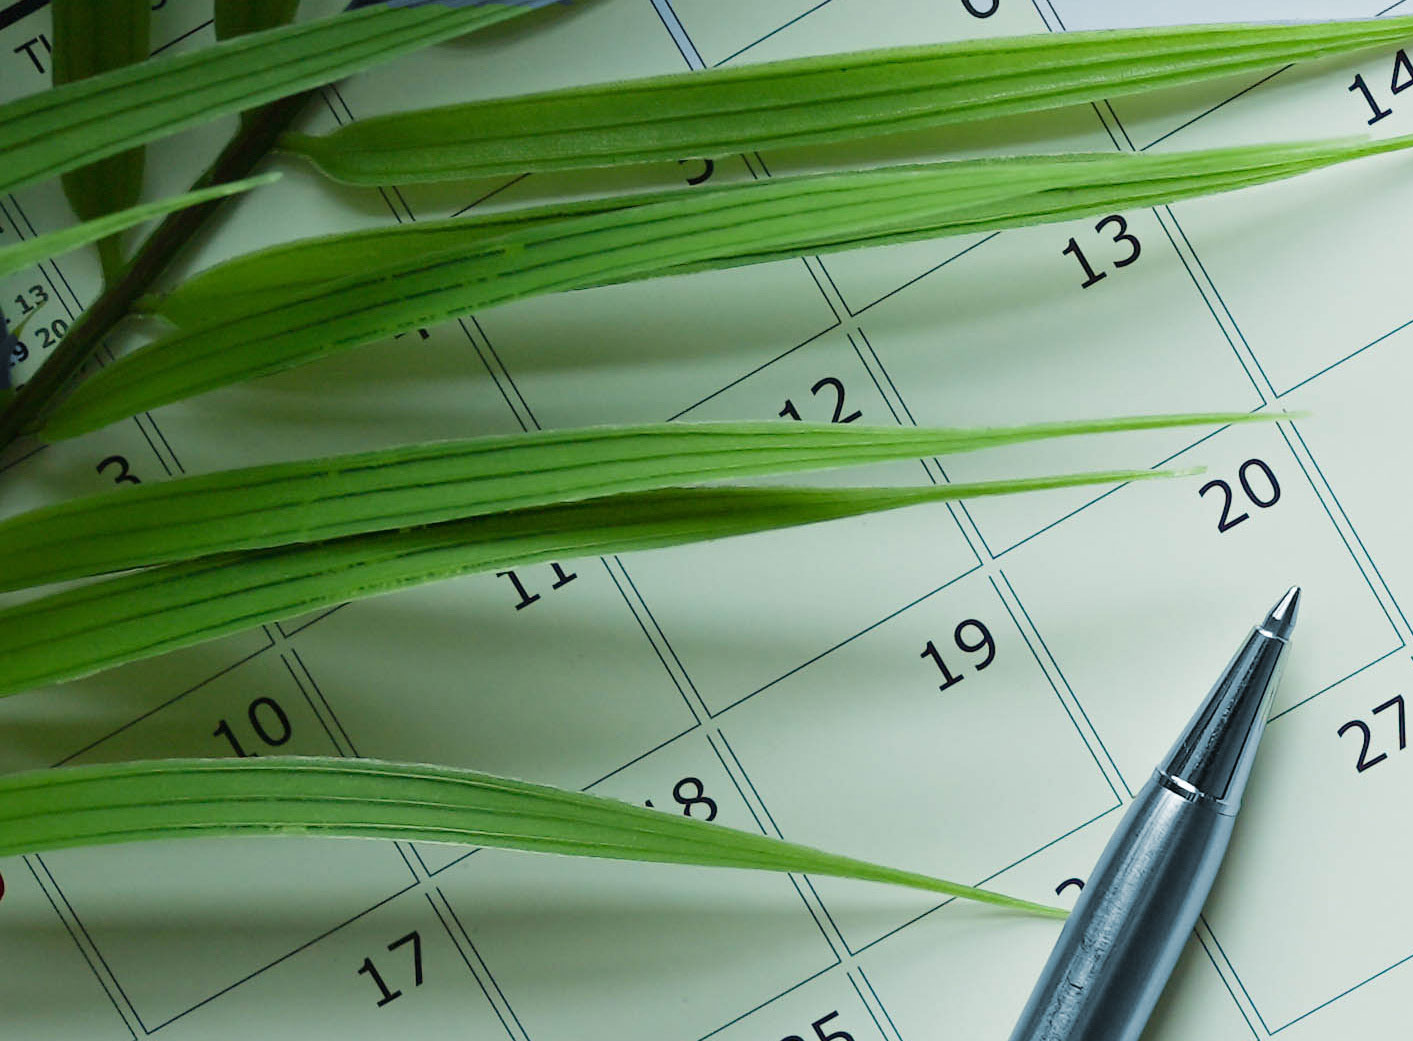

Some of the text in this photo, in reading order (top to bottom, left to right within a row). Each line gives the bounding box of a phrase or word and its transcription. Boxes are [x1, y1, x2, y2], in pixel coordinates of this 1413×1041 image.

[1062, 214, 1142, 289] 13
[14, 284, 49, 315] 13
[35, 319, 68, 349] 20
[1198, 458, 1281, 534] 20
[920, 618, 996, 692] 19
[213, 697, 292, 758] 10
[1336, 694, 1407, 774] 27
[644, 777, 718, 822] 8
[357, 930, 423, 1008] 17
